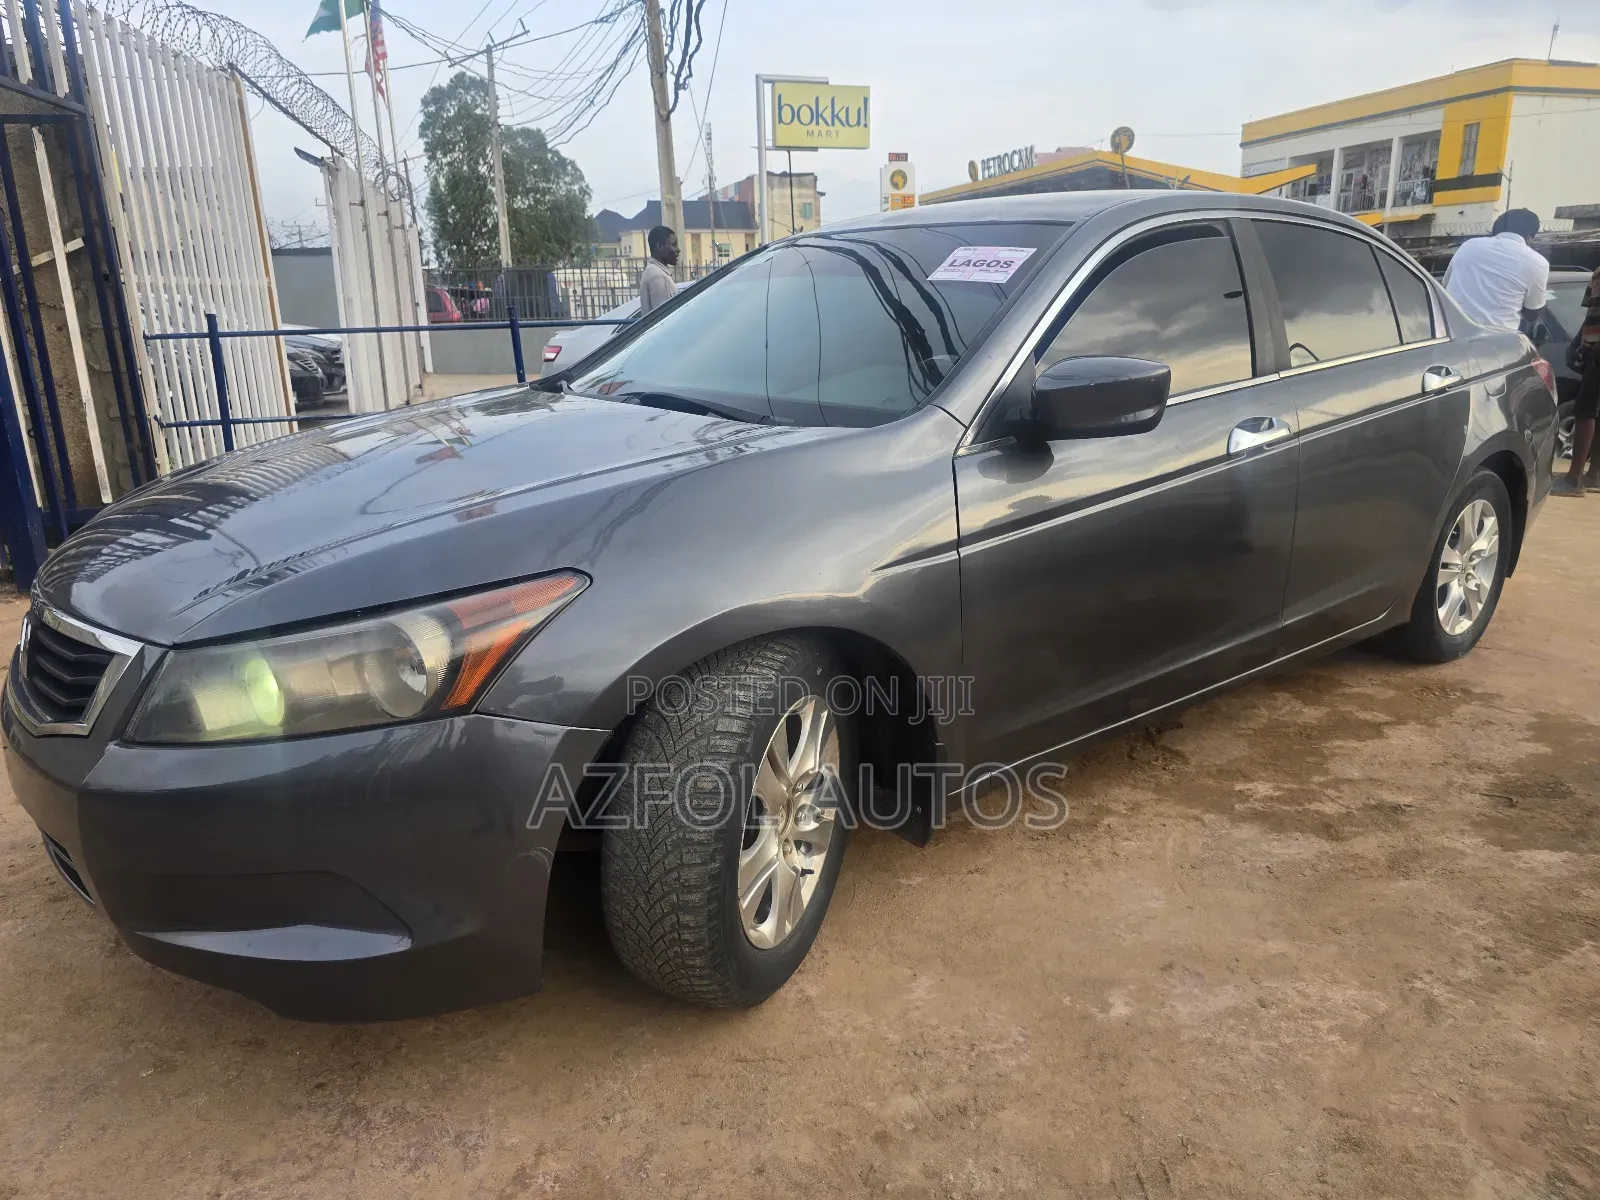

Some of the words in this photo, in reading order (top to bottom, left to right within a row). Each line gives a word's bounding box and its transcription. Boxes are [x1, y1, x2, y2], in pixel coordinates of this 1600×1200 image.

[777, 93, 869, 128] bokku!
[806, 129, 840, 138] MART
[980, 145, 1035, 180] PETROCAM
[948, 259, 1015, 269] LAGOS
